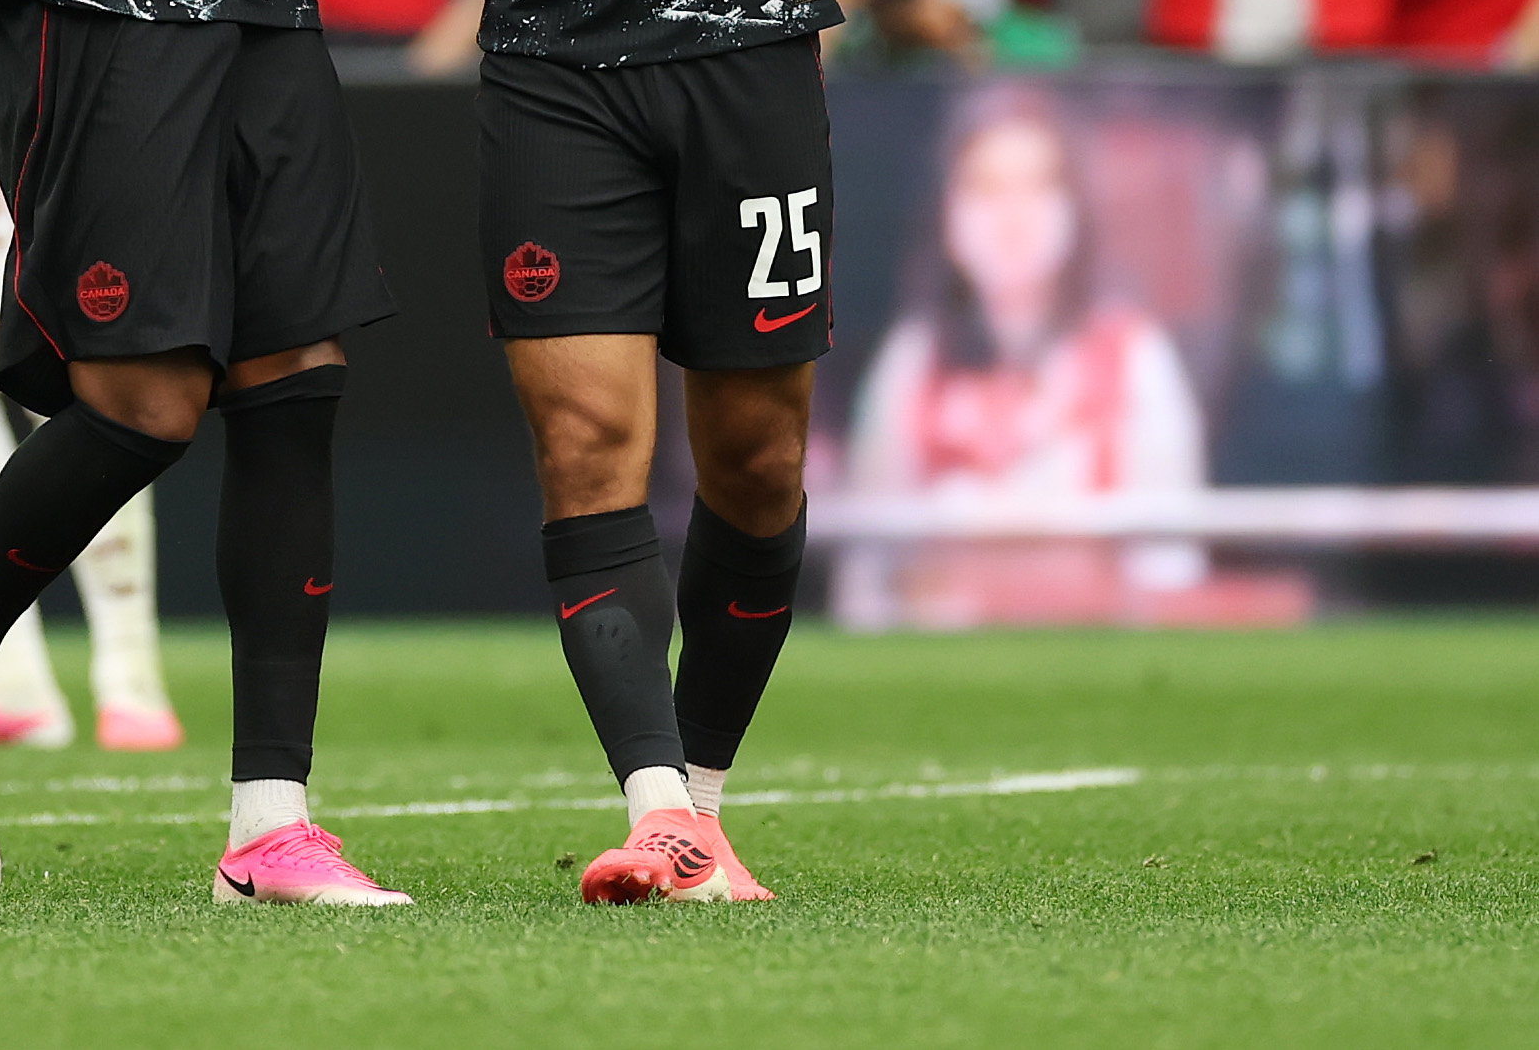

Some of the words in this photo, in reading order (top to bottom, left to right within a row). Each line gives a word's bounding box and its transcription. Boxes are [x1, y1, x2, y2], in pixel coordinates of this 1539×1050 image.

[739, 187, 822, 299] 25
[506, 268, 556, 280] CANADA
[79, 287, 126, 299] CANADA
